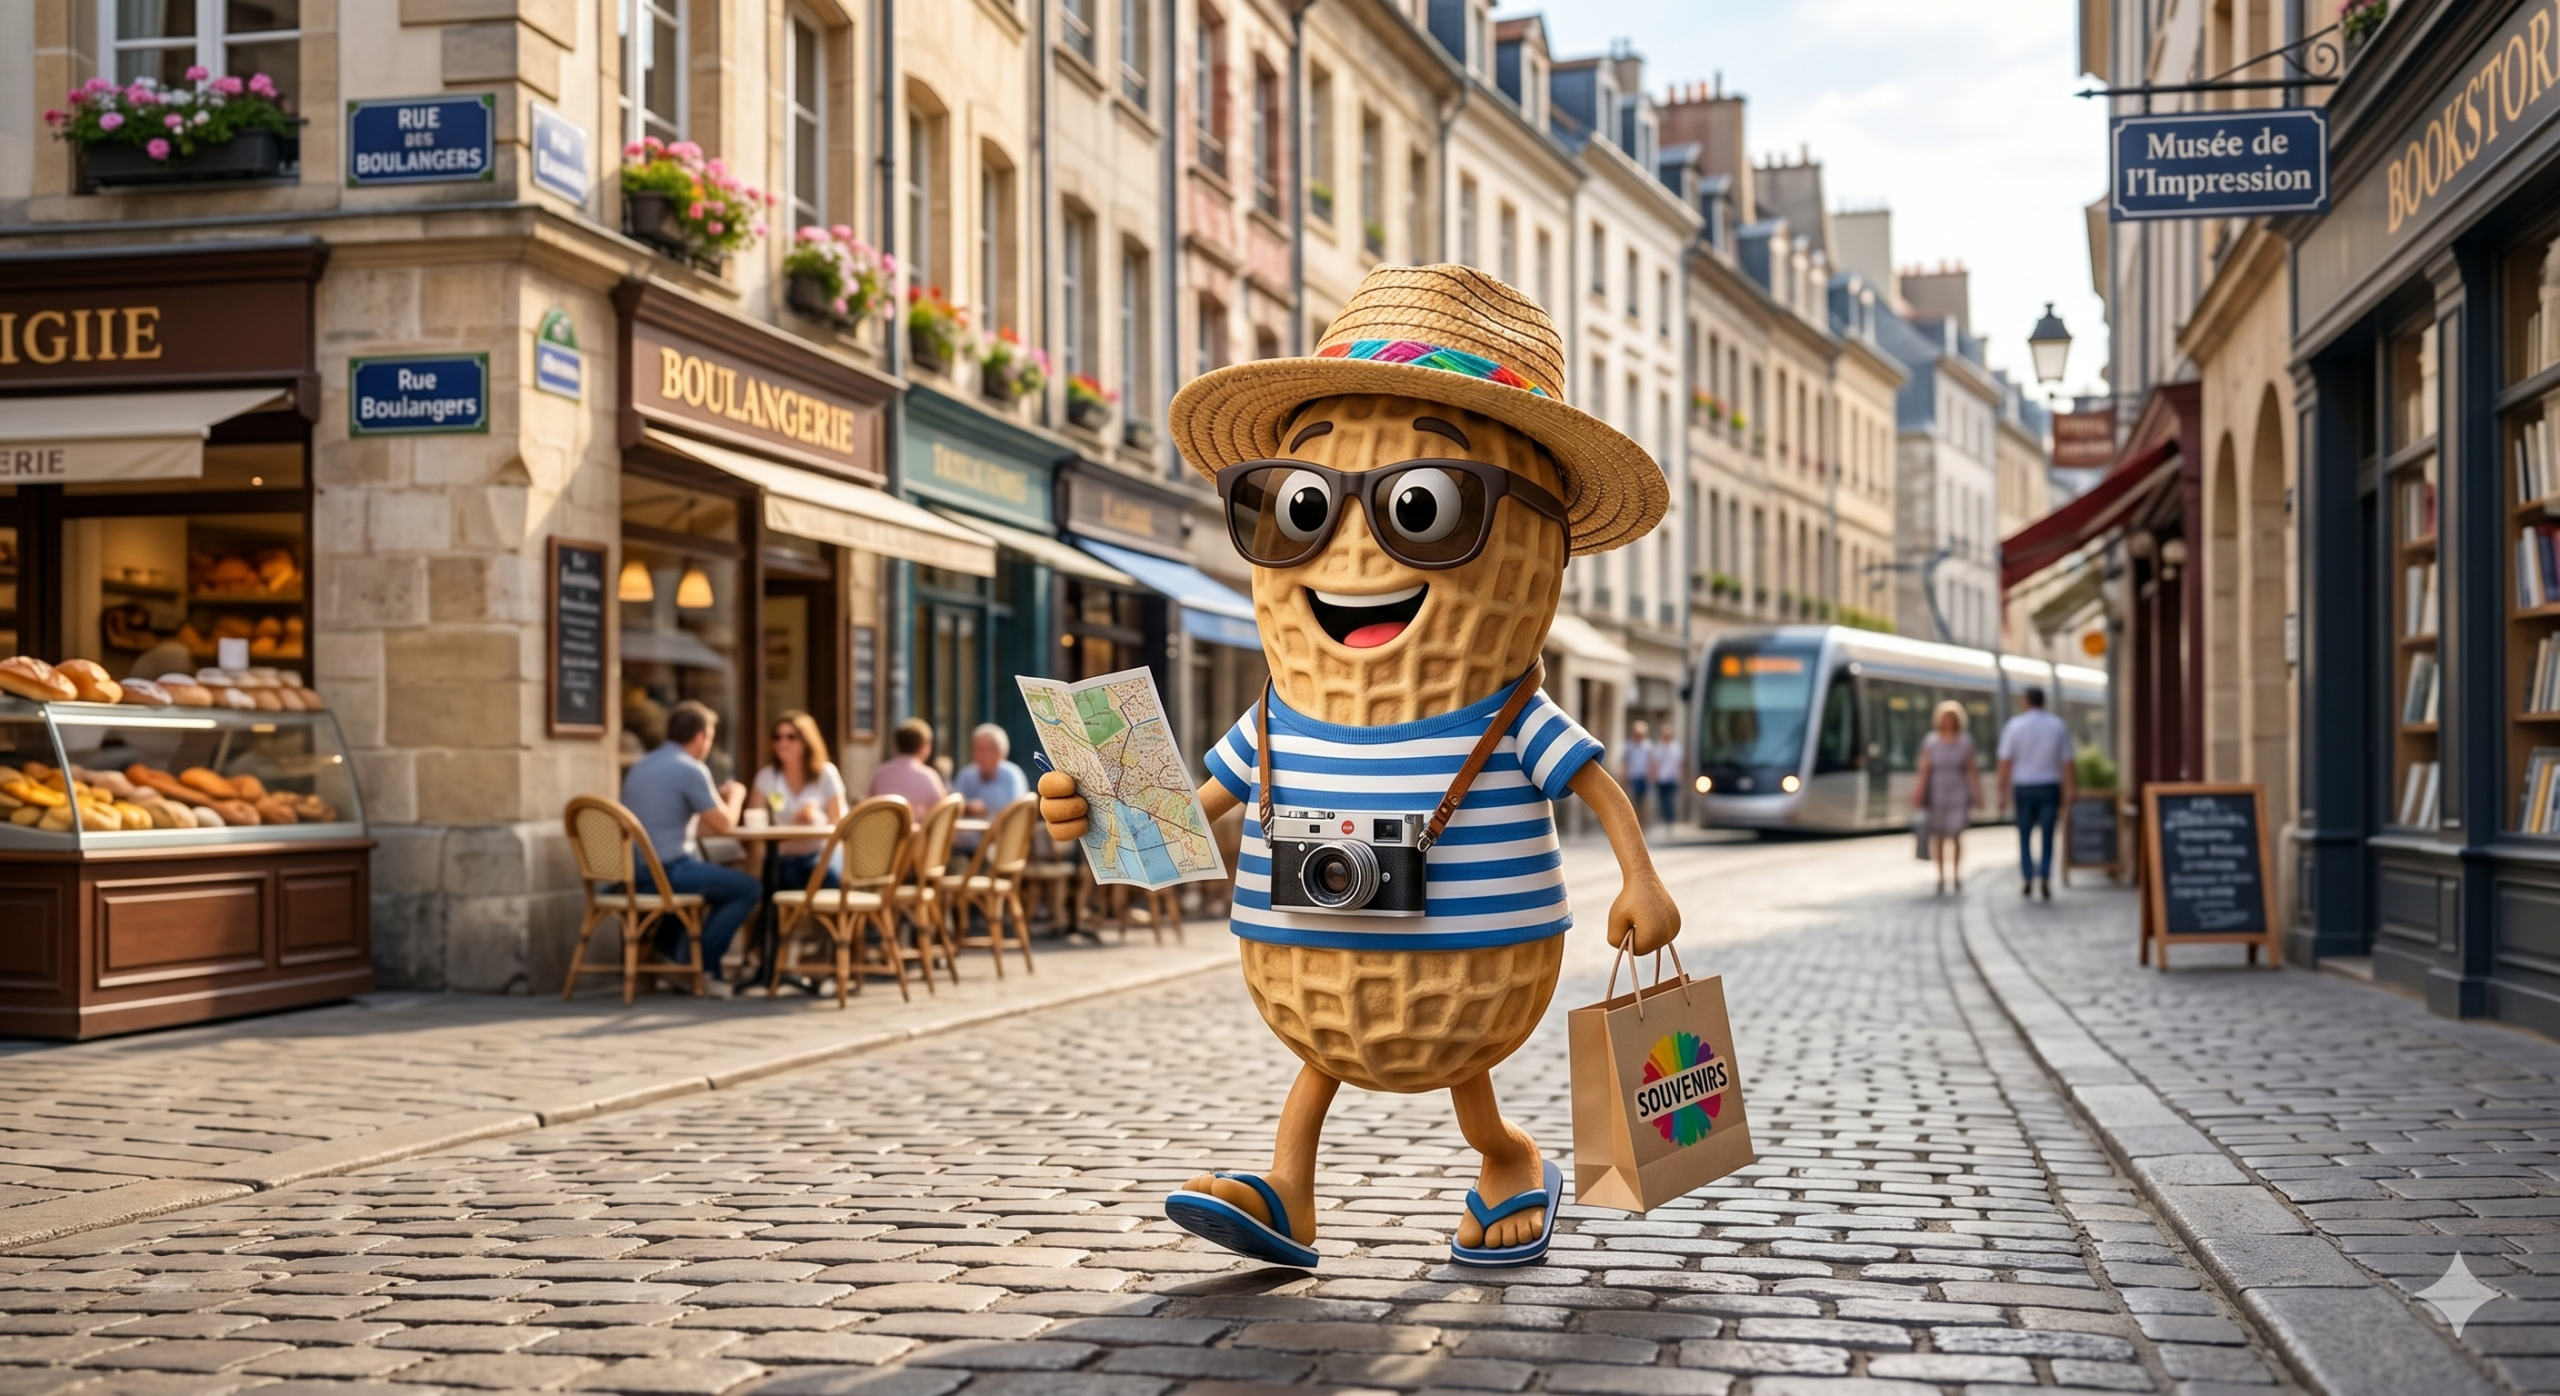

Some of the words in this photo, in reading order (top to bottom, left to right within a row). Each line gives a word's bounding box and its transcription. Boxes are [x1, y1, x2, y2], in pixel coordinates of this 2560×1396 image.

[398, 107, 441, 130] RUE
[2387, 0, 2560, 235] BOOKSTOR
[405, 132, 434, 148] DES
[2146, 129, 2244, 160] Musée
[2252, 127, 2289, 155] de
[356, 148, 482, 174] BOULANGERS
[2126, 163, 2312, 202] l'Impression
[398, 369, 437, 391] Rue
[361, 395, 477, 423] Boulangers
[660, 346, 855, 455] BOULANGERIE
[1637, 1061, 1728, 1118] SOUVENIRS
